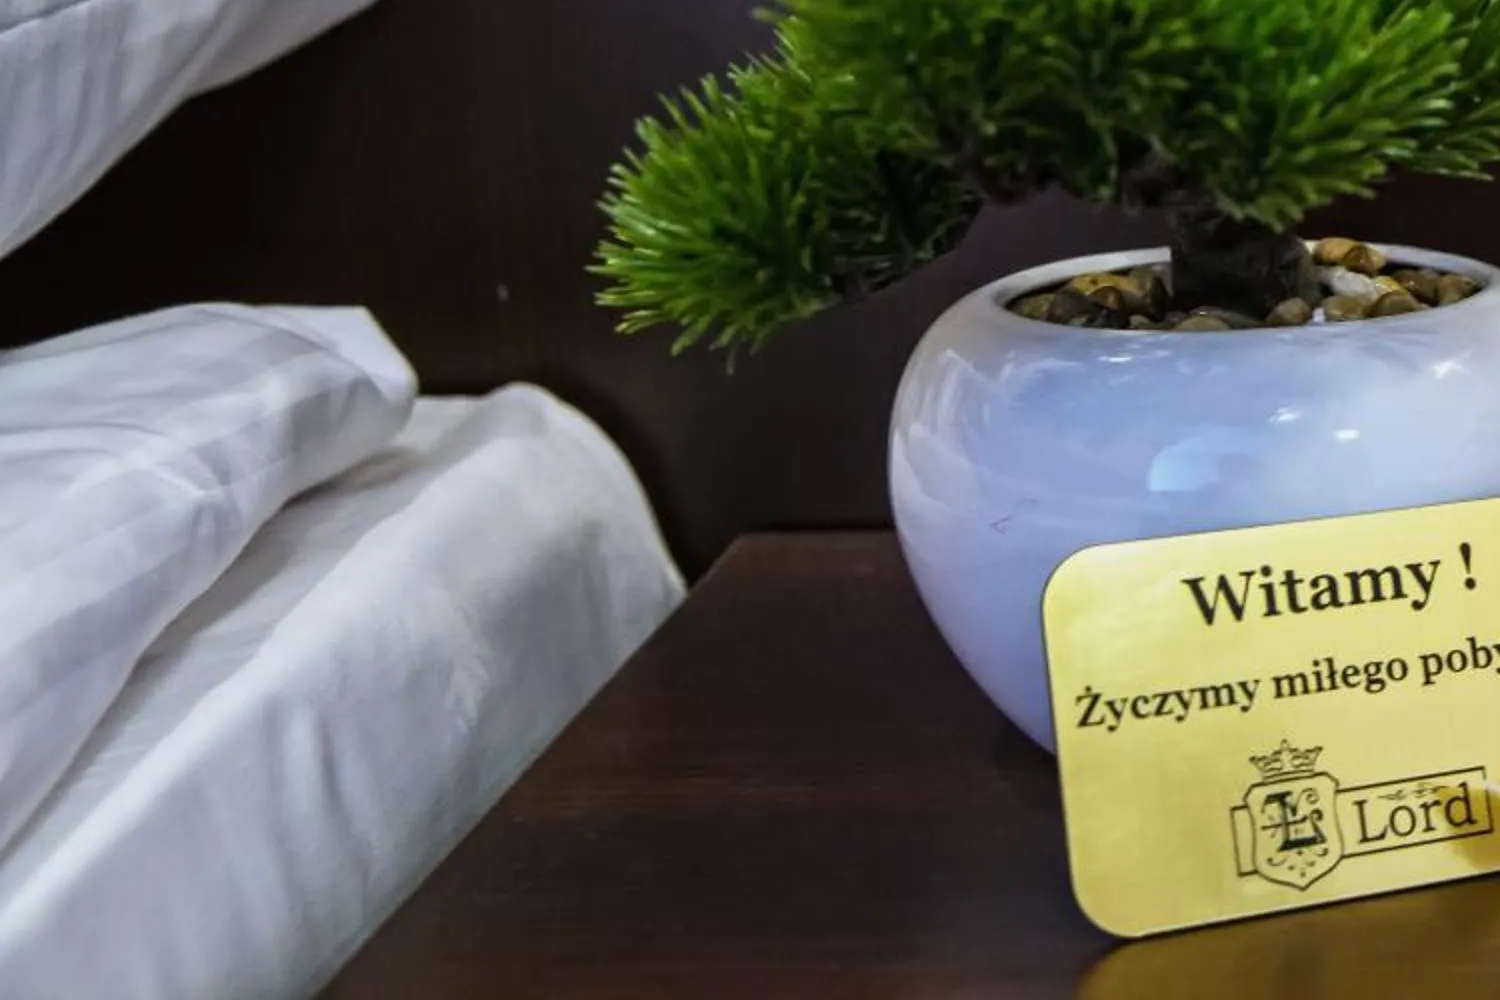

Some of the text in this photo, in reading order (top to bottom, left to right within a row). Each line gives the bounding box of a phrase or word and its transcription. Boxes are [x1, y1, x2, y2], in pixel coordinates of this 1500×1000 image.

[1182, 542, 1477, 626] Witamy !
[1076, 681, 1258, 733] Życzymy
[1272, 657, 1408, 699] miłego
[1353, 781, 1478, 844] Lord
